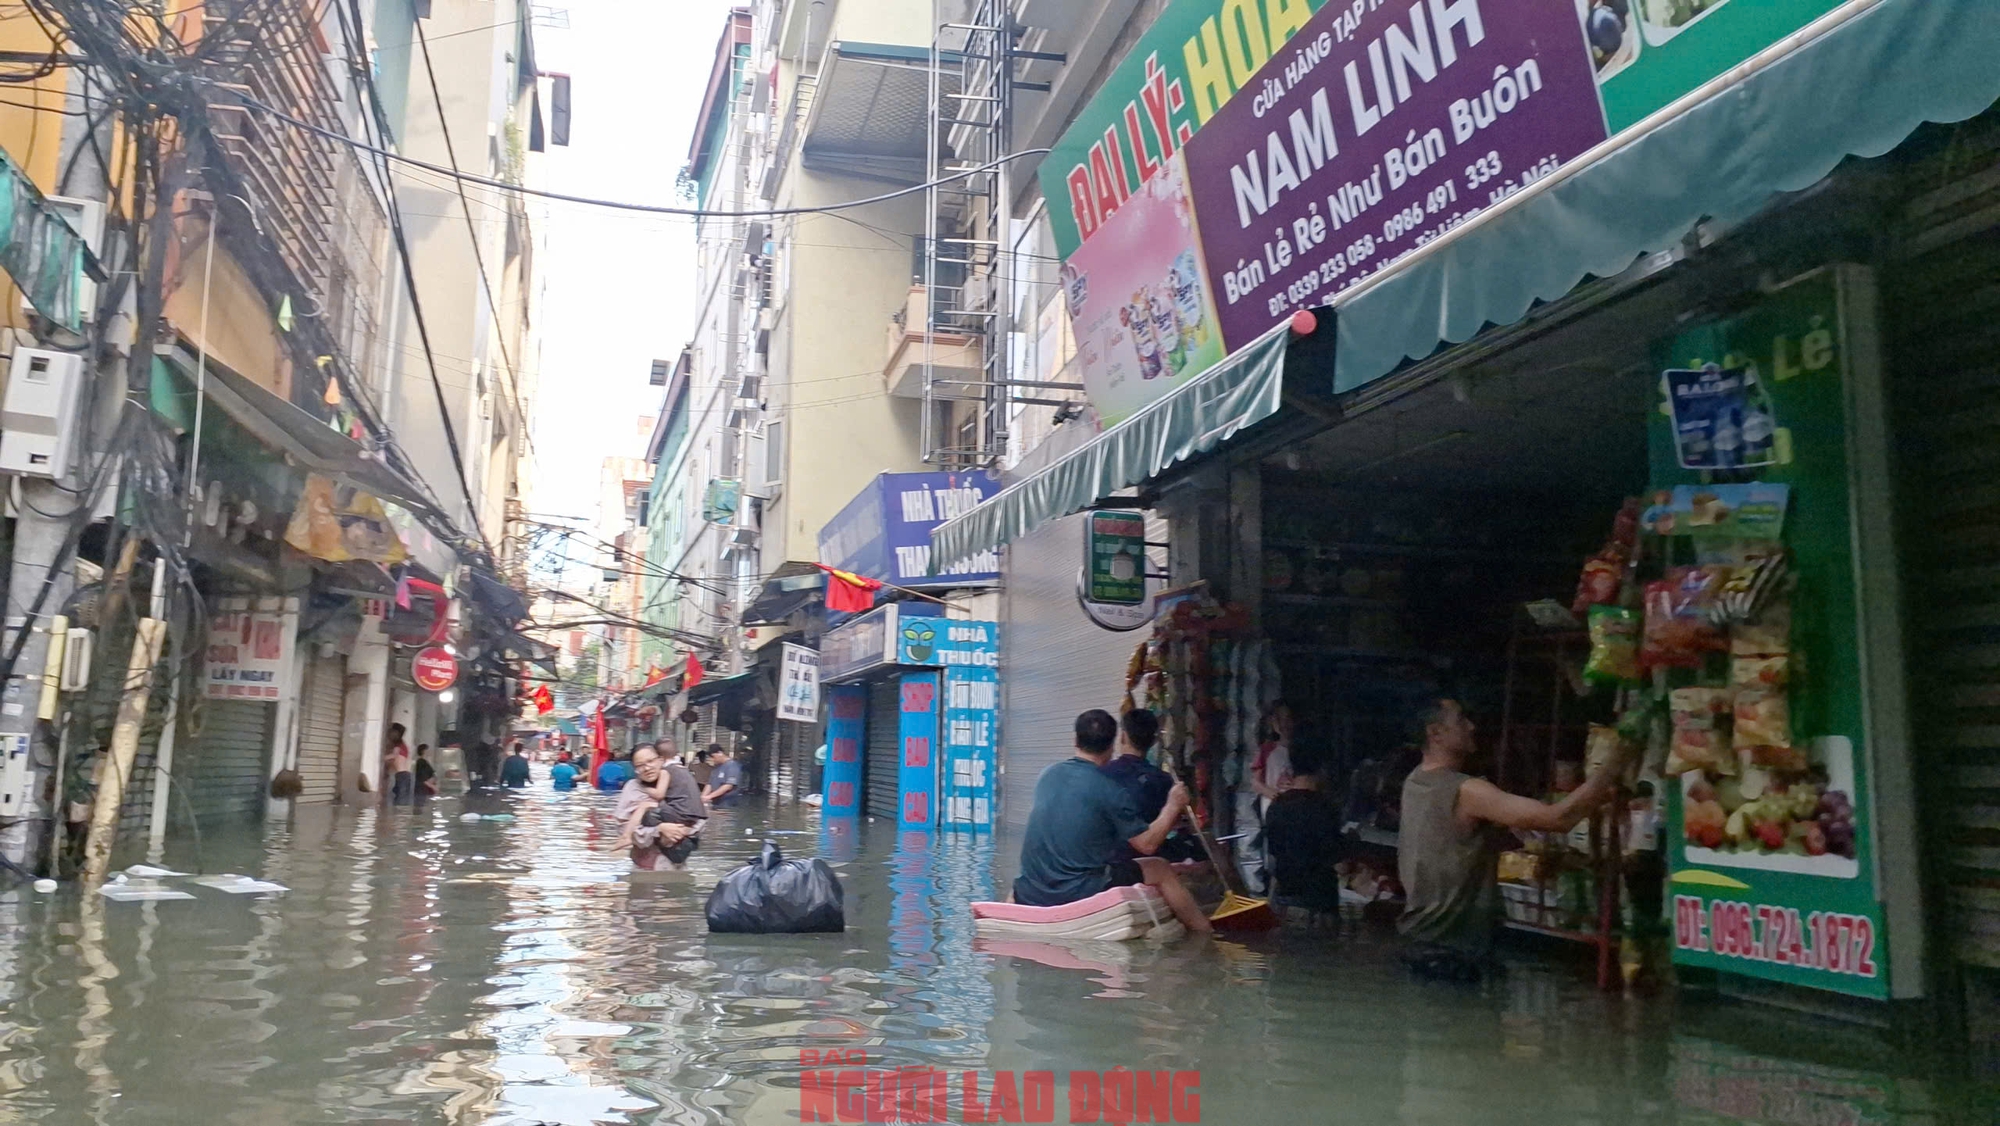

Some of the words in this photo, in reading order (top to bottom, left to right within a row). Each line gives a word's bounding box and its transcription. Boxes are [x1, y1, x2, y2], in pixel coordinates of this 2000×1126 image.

[1253, 78, 1286, 118] CỬA
[1284, 31, 1332, 89] HÀNG
[1332, 0, 1367, 43] TẠP
[1230, 87, 1340, 229] NAM
[1344, 0, 1486, 137] LINH
[1223, 257, 1265, 305] Bán
[1264, 227, 1293, 276] Lẻ
[1293, 202, 1327, 255] Rẻ
[1327, 164, 1384, 231] Như
[1384, 129, 1447, 191] Bán
[1448, 58, 1543, 146] Buôn
[1287, 270, 1319, 304] 0339
[1319, 253, 1347, 285] 233
[1346, 234, 1376, 266] 058
[1383, 202, 1425, 242] 0986
[1425, 179, 1458, 214] 491
[1464, 150, 1503, 190] 333
[1773, 314, 1835, 381] Lẻ
[901, 483, 935, 523] NHÀ
[936, 647, 999, 666] THUỐC
[948, 626, 988, 643] NHÀ
[1674, 895, 1708, 952] ĐT:
[1711, 899, 1878, 978] 096.724.1872
